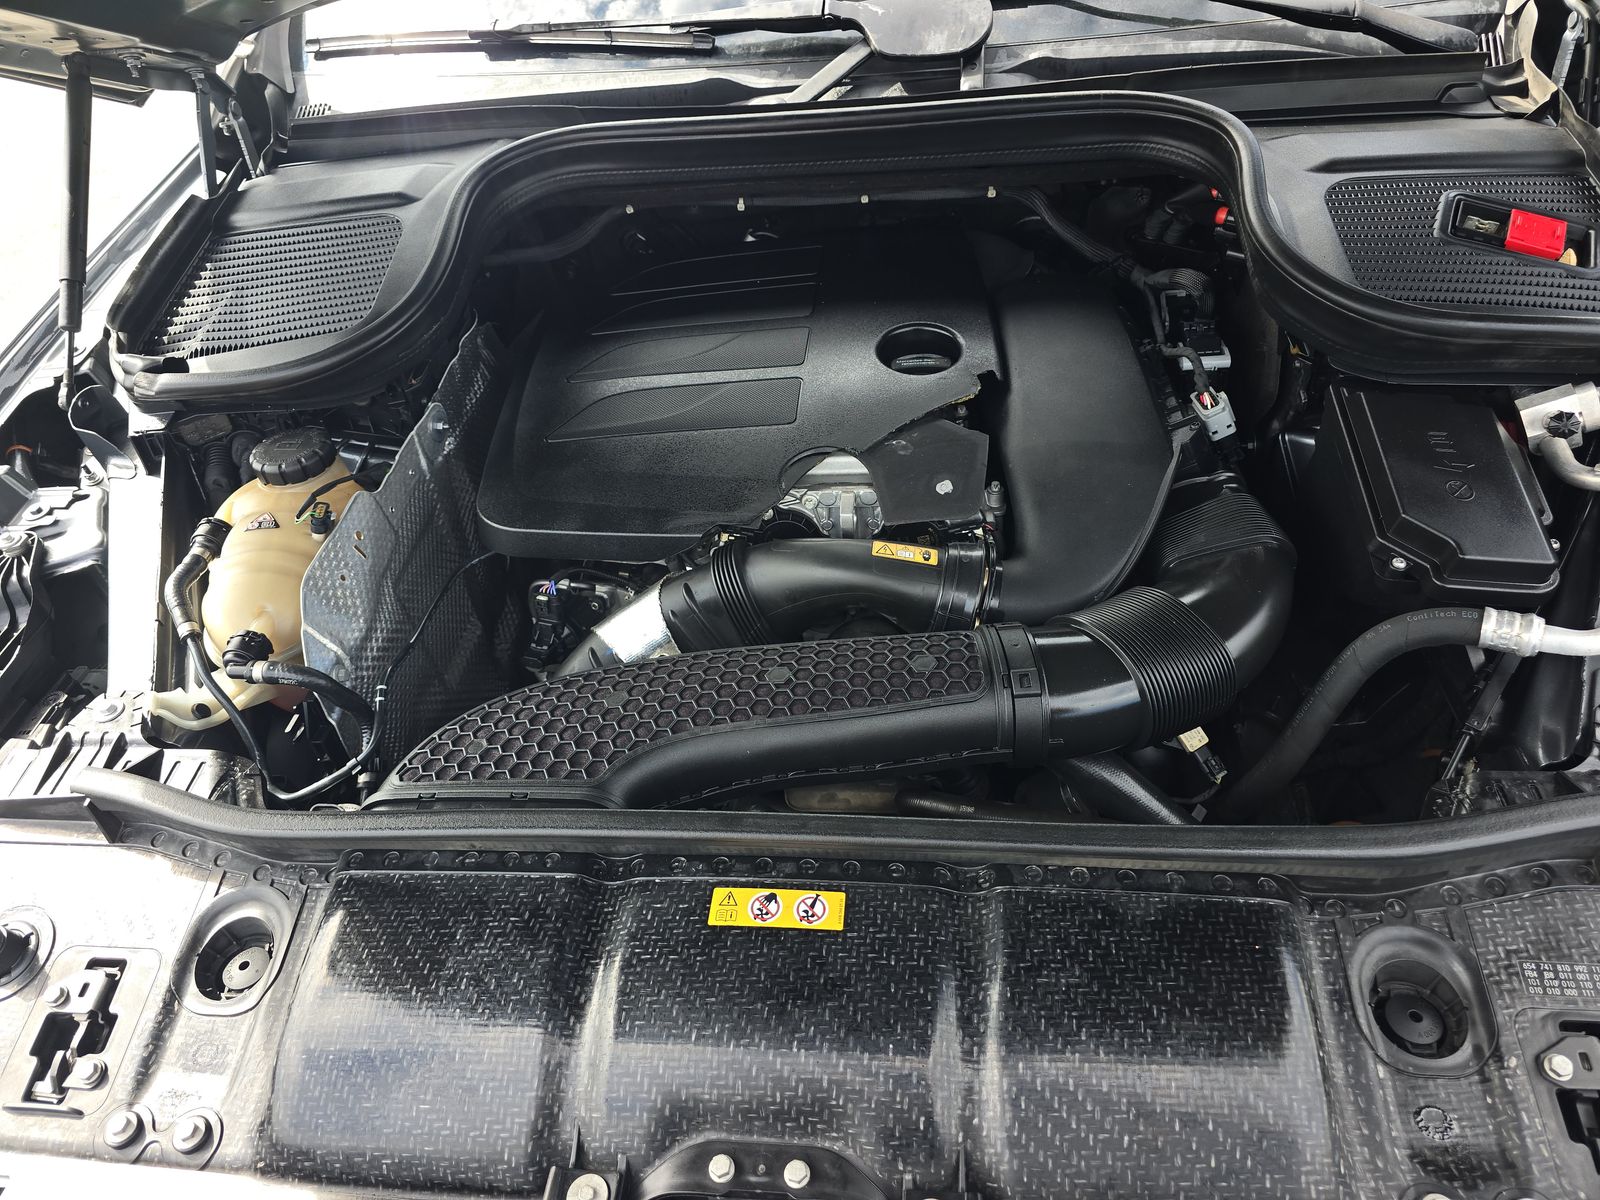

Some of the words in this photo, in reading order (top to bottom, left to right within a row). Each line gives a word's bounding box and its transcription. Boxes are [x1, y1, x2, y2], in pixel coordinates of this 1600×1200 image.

[1406, 610, 1457, 622] ContiTech
[1461, 611, 1478, 619] ECO
[1522, 962, 1537, 970] 654
[1556, 964, 1571, 972] 810
[1573, 965, 1588, 973] 992
[1576, 973, 1590, 981] 001
[1528, 978, 1541, 986] 101
[1544, 979, 1558, 987] 010
[1561, 980, 1576, 988] 010
[1579, 981, 1593, 989] 110
[1529, 986, 1543, 994] 010
[1546, 987, 1561, 995] 010
[1563, 988, 1578, 996] 000
[1582, 989, 1595, 997] 111
